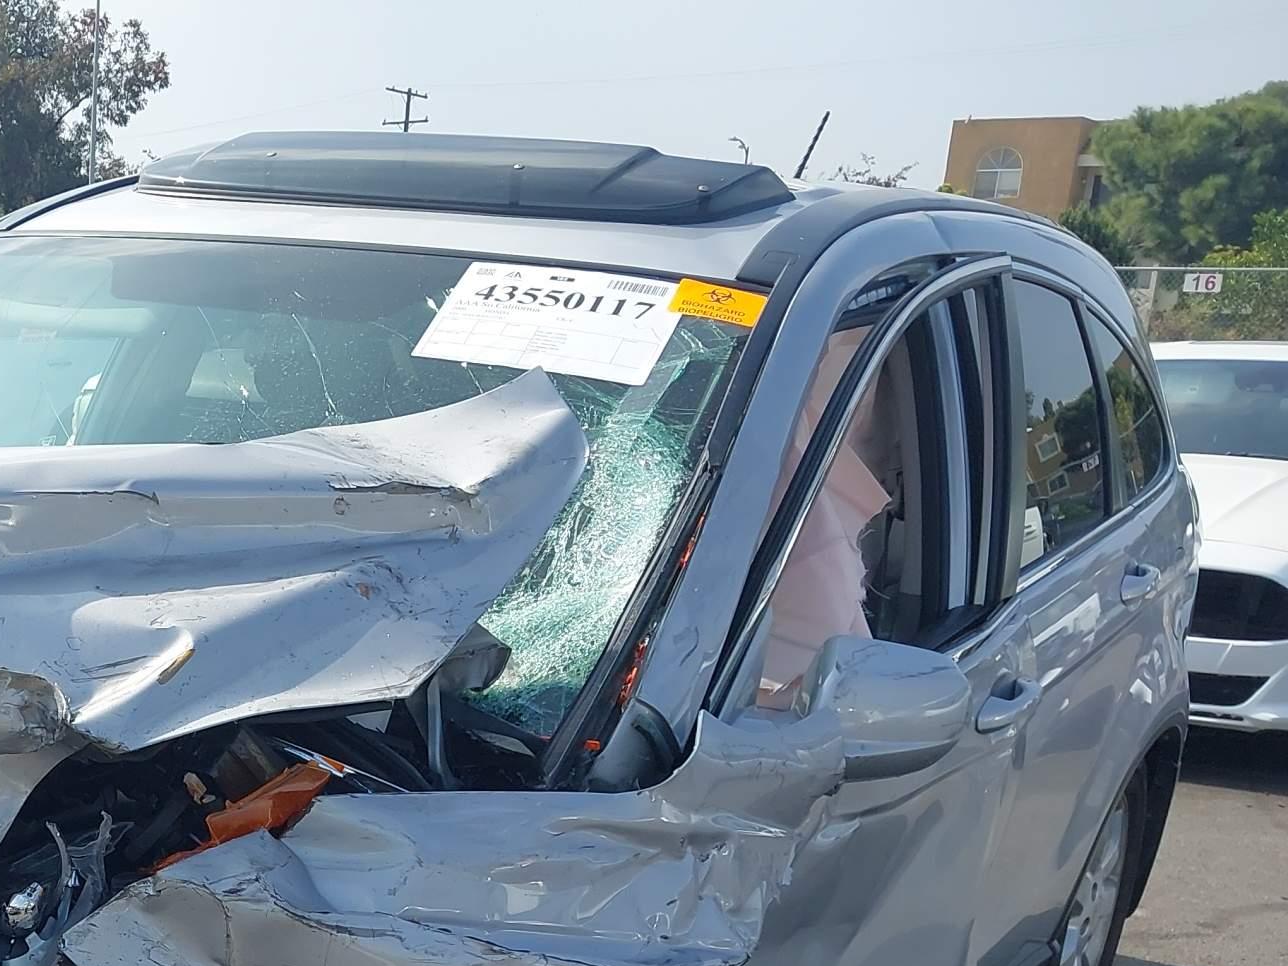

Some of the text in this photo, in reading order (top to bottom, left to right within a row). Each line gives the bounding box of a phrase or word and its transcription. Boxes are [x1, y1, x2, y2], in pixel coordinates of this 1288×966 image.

[1192, 275, 1216, 290] 16
[475, 284, 656, 319] 43550117
[682, 300, 746, 317] BIOHAZARD
[678, 307, 743, 323] BIOPELIGRO
